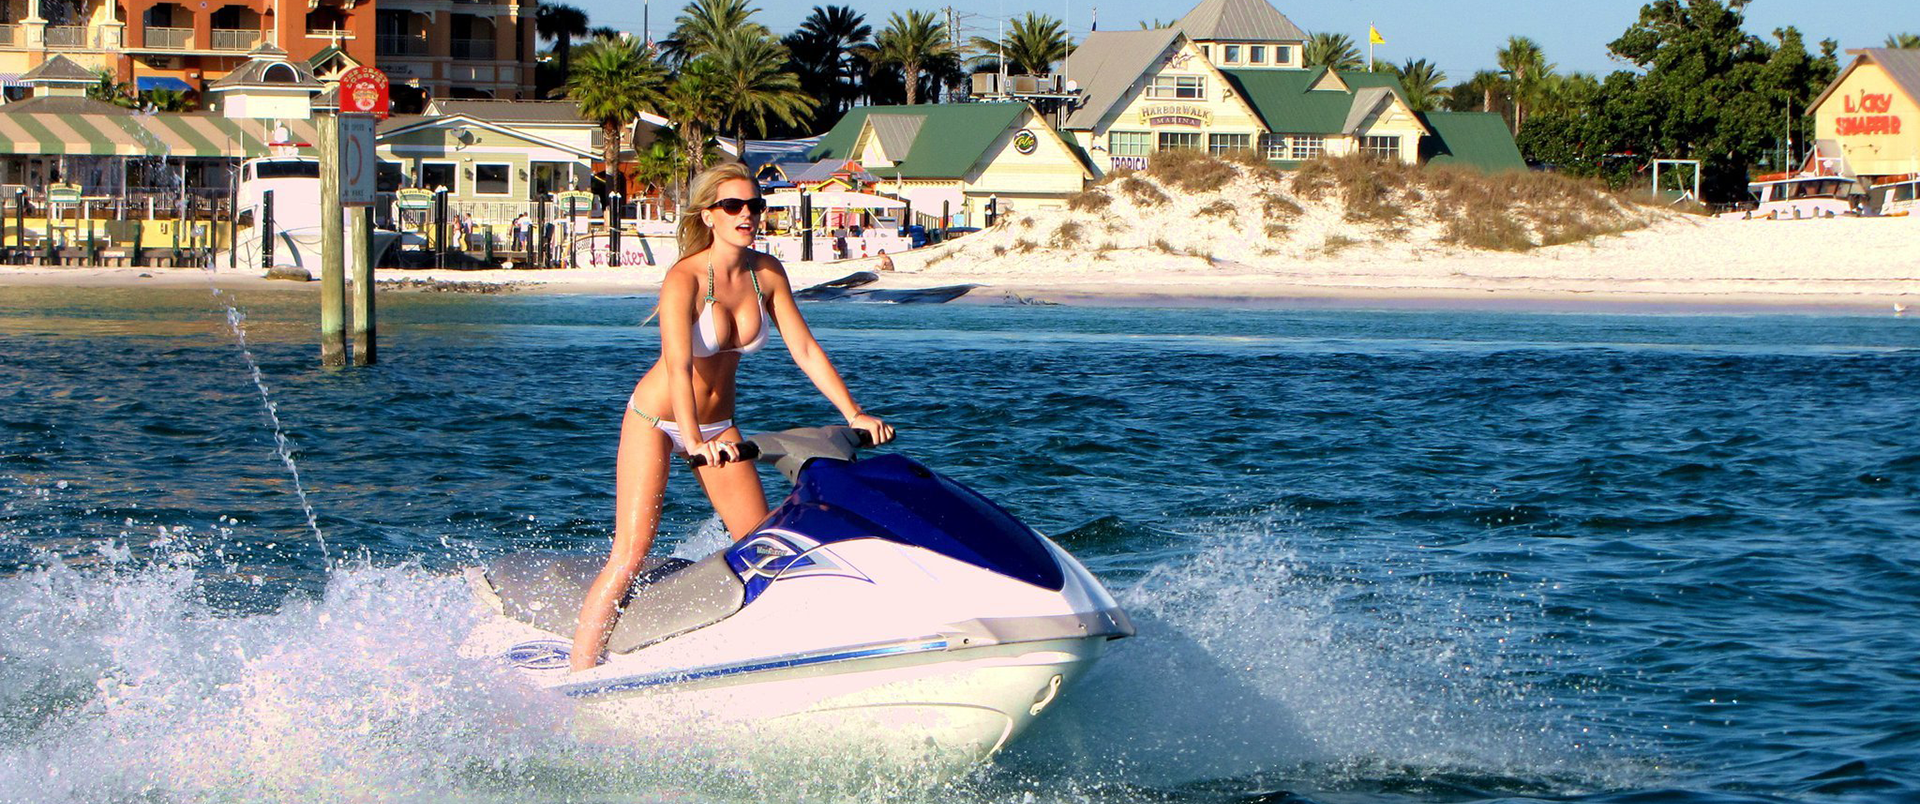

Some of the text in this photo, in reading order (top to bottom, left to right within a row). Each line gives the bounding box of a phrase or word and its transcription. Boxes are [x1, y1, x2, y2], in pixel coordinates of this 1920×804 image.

[1155, 116, 1196, 125] MARINA
[1835, 115, 1902, 136] SNAPPER
[1110, 157, 1149, 171] TROPICA
